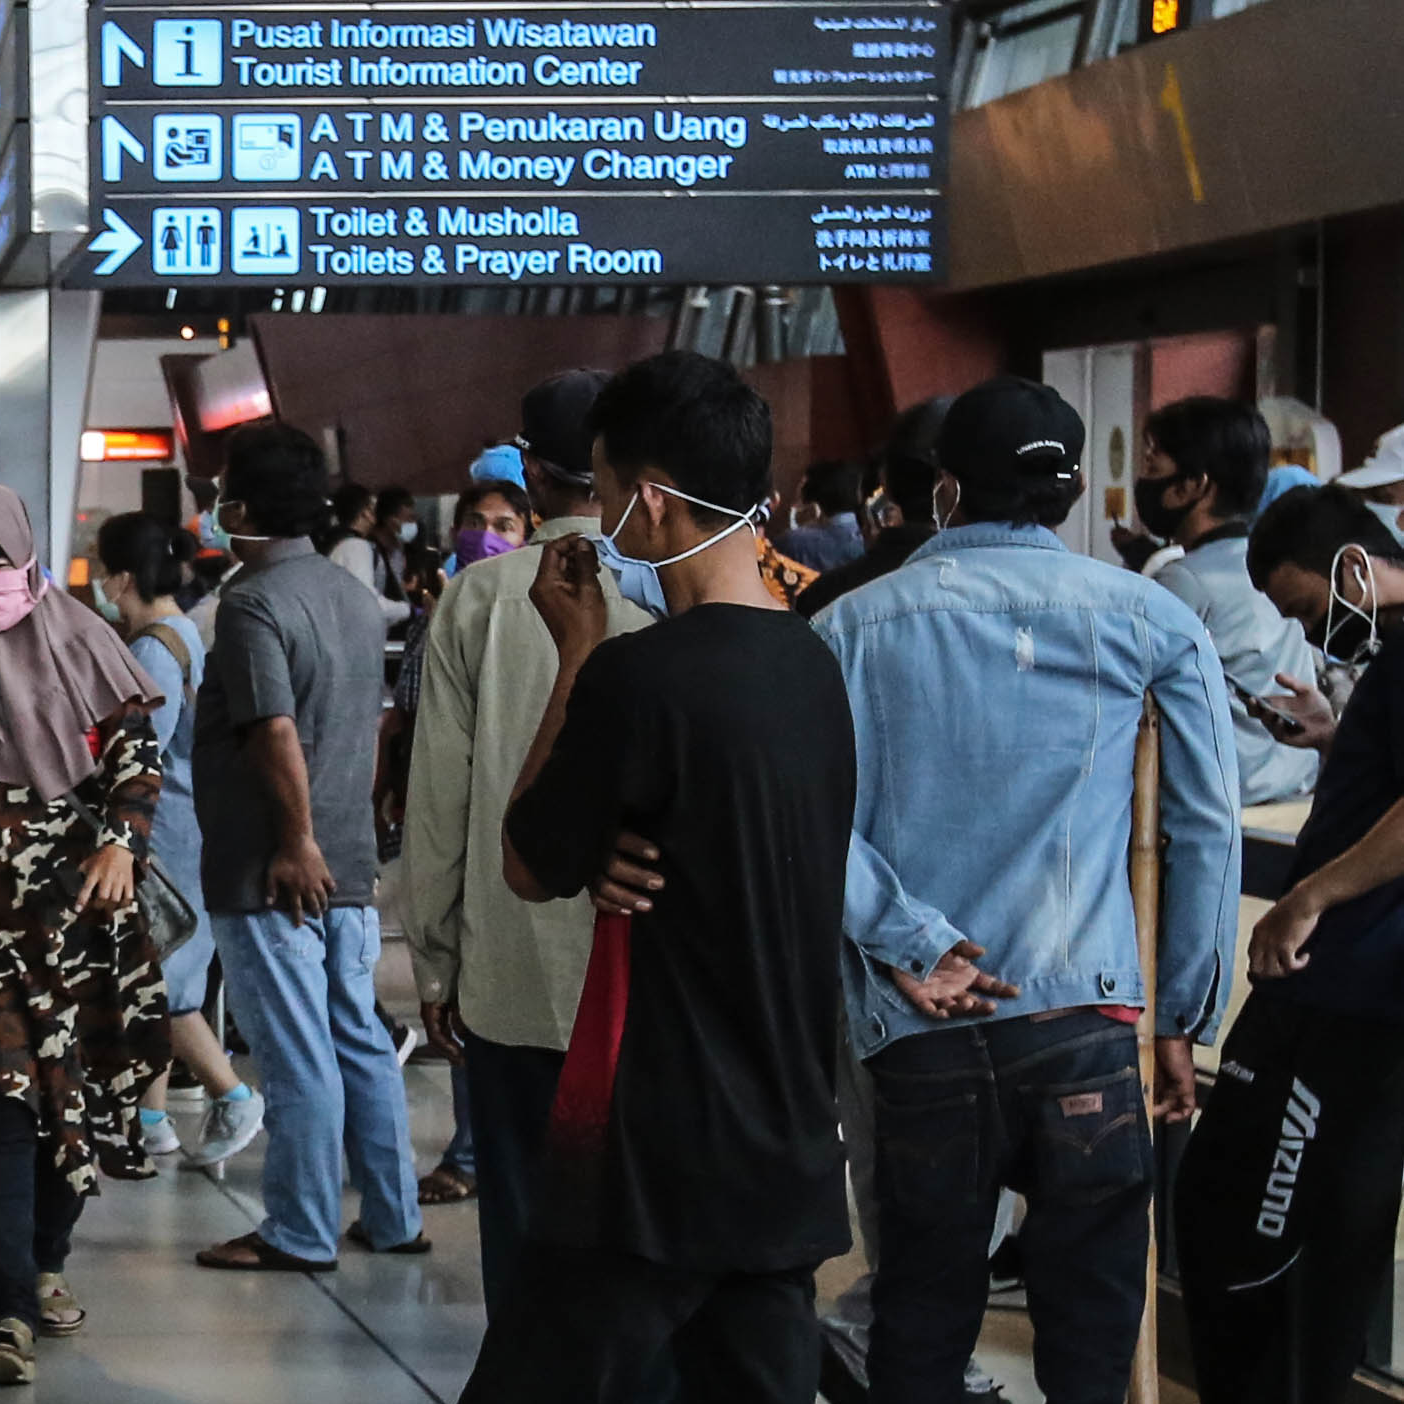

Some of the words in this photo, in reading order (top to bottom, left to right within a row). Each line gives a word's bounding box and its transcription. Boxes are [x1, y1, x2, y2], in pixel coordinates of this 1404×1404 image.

[231, 18, 324, 49] Pusat
[330, 17, 476, 48] Informasi
[482, 17, 658, 48] Wisatawan
[230, 55, 343, 87] Tourist
[349, 55, 527, 86] Information
[533, 54, 644, 86] Center
[421, 111, 451, 143] &
[459, 111, 646, 142] Penukaran
[654, 110, 748, 148] Uang
[421, 150, 450, 181] &
[458, 149, 577, 187] Money
[582, 149, 735, 187] Changer
[307, 206, 399, 237] Toilet
[403, 206, 431, 237] &
[437, 205, 580, 237] Musholla
[307, 243, 415, 275] Toilets
[420, 244, 448, 275] &
[455, 243, 562, 281] Prayer
[567, 242, 663, 274] Room
